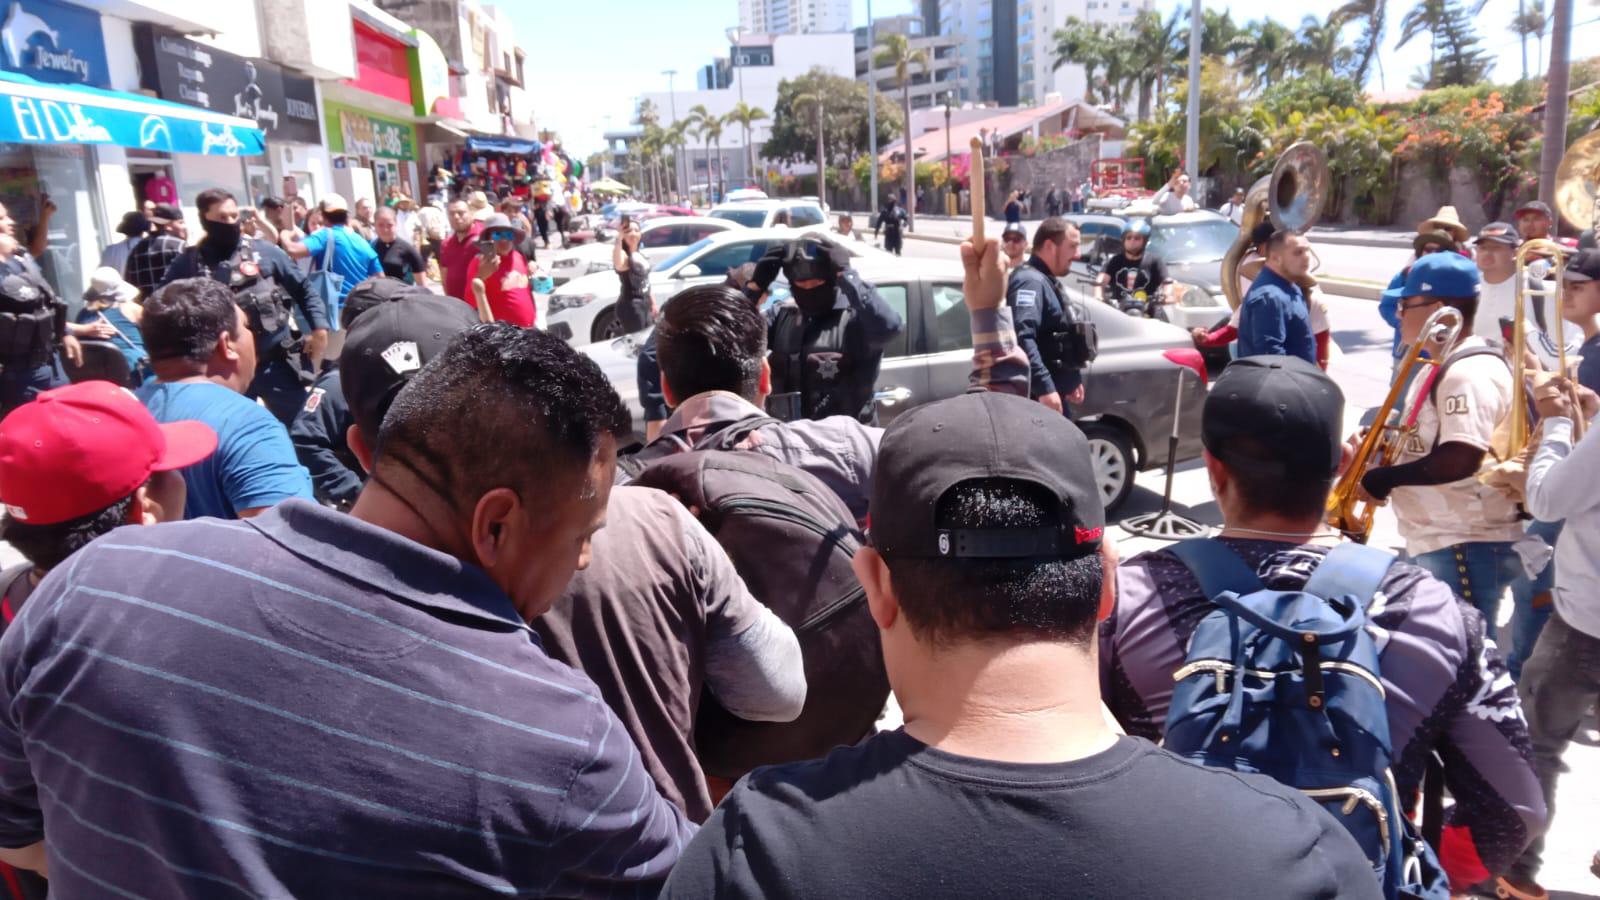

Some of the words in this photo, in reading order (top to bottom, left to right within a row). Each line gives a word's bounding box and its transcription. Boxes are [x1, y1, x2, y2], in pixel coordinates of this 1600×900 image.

[36, 46, 88, 81] Jewelry
[10, 95, 45, 140] El
[1445, 395, 1468, 415] 01
